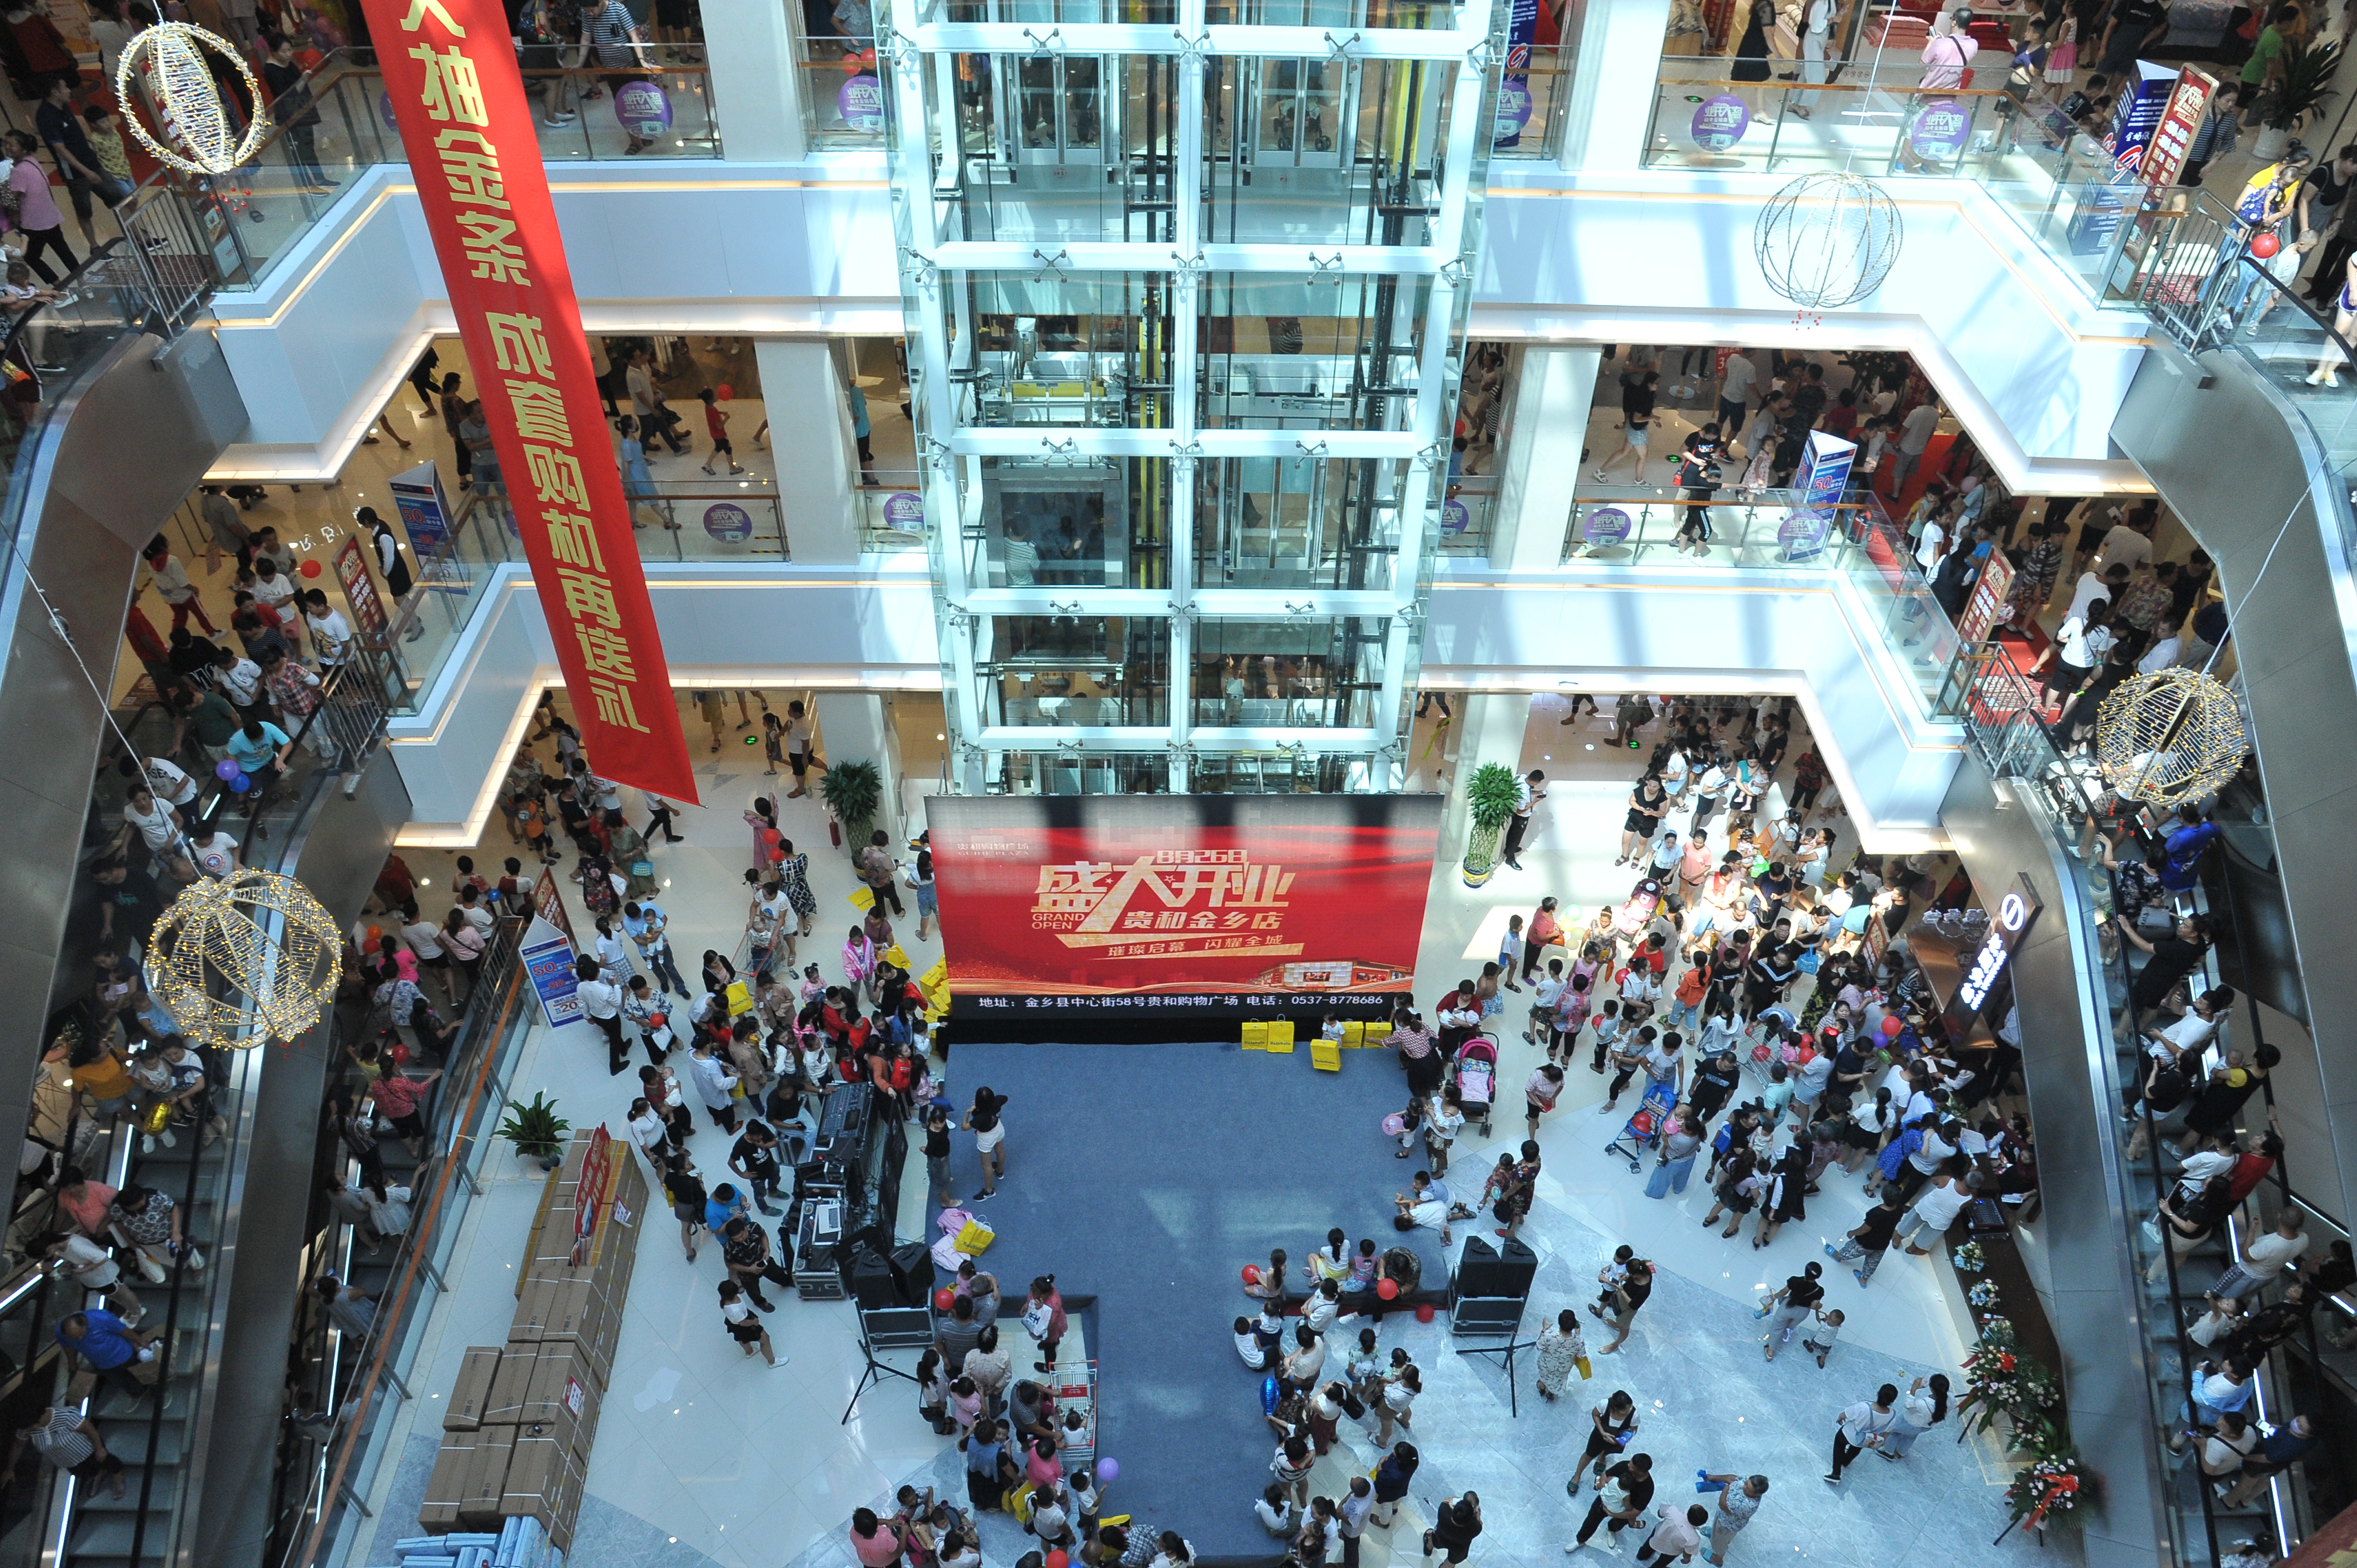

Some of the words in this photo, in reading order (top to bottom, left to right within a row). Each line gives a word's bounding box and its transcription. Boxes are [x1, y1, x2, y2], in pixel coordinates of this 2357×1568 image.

[402, 507, 425, 524] 50
[485, 312, 650, 734] 成套购机再送礼
[1156, 849, 1247, 864] 8月26日
[1031, 855, 1296, 932] 盛大开业
[1032, 913, 1085, 921] GRAND
[1121, 910, 1284, 930] 贵和金乡店
[1032, 921, 1073, 930] OPEN
[1108, 941, 1186, 957] 璀璨启幕
[1204, 935, 1284, 950] 闪耀全城
[532, 961, 557, 977] 50
[560, 1002, 578, 1013] 20
[1291, 996, 1383, 1005] 0537-8778686
